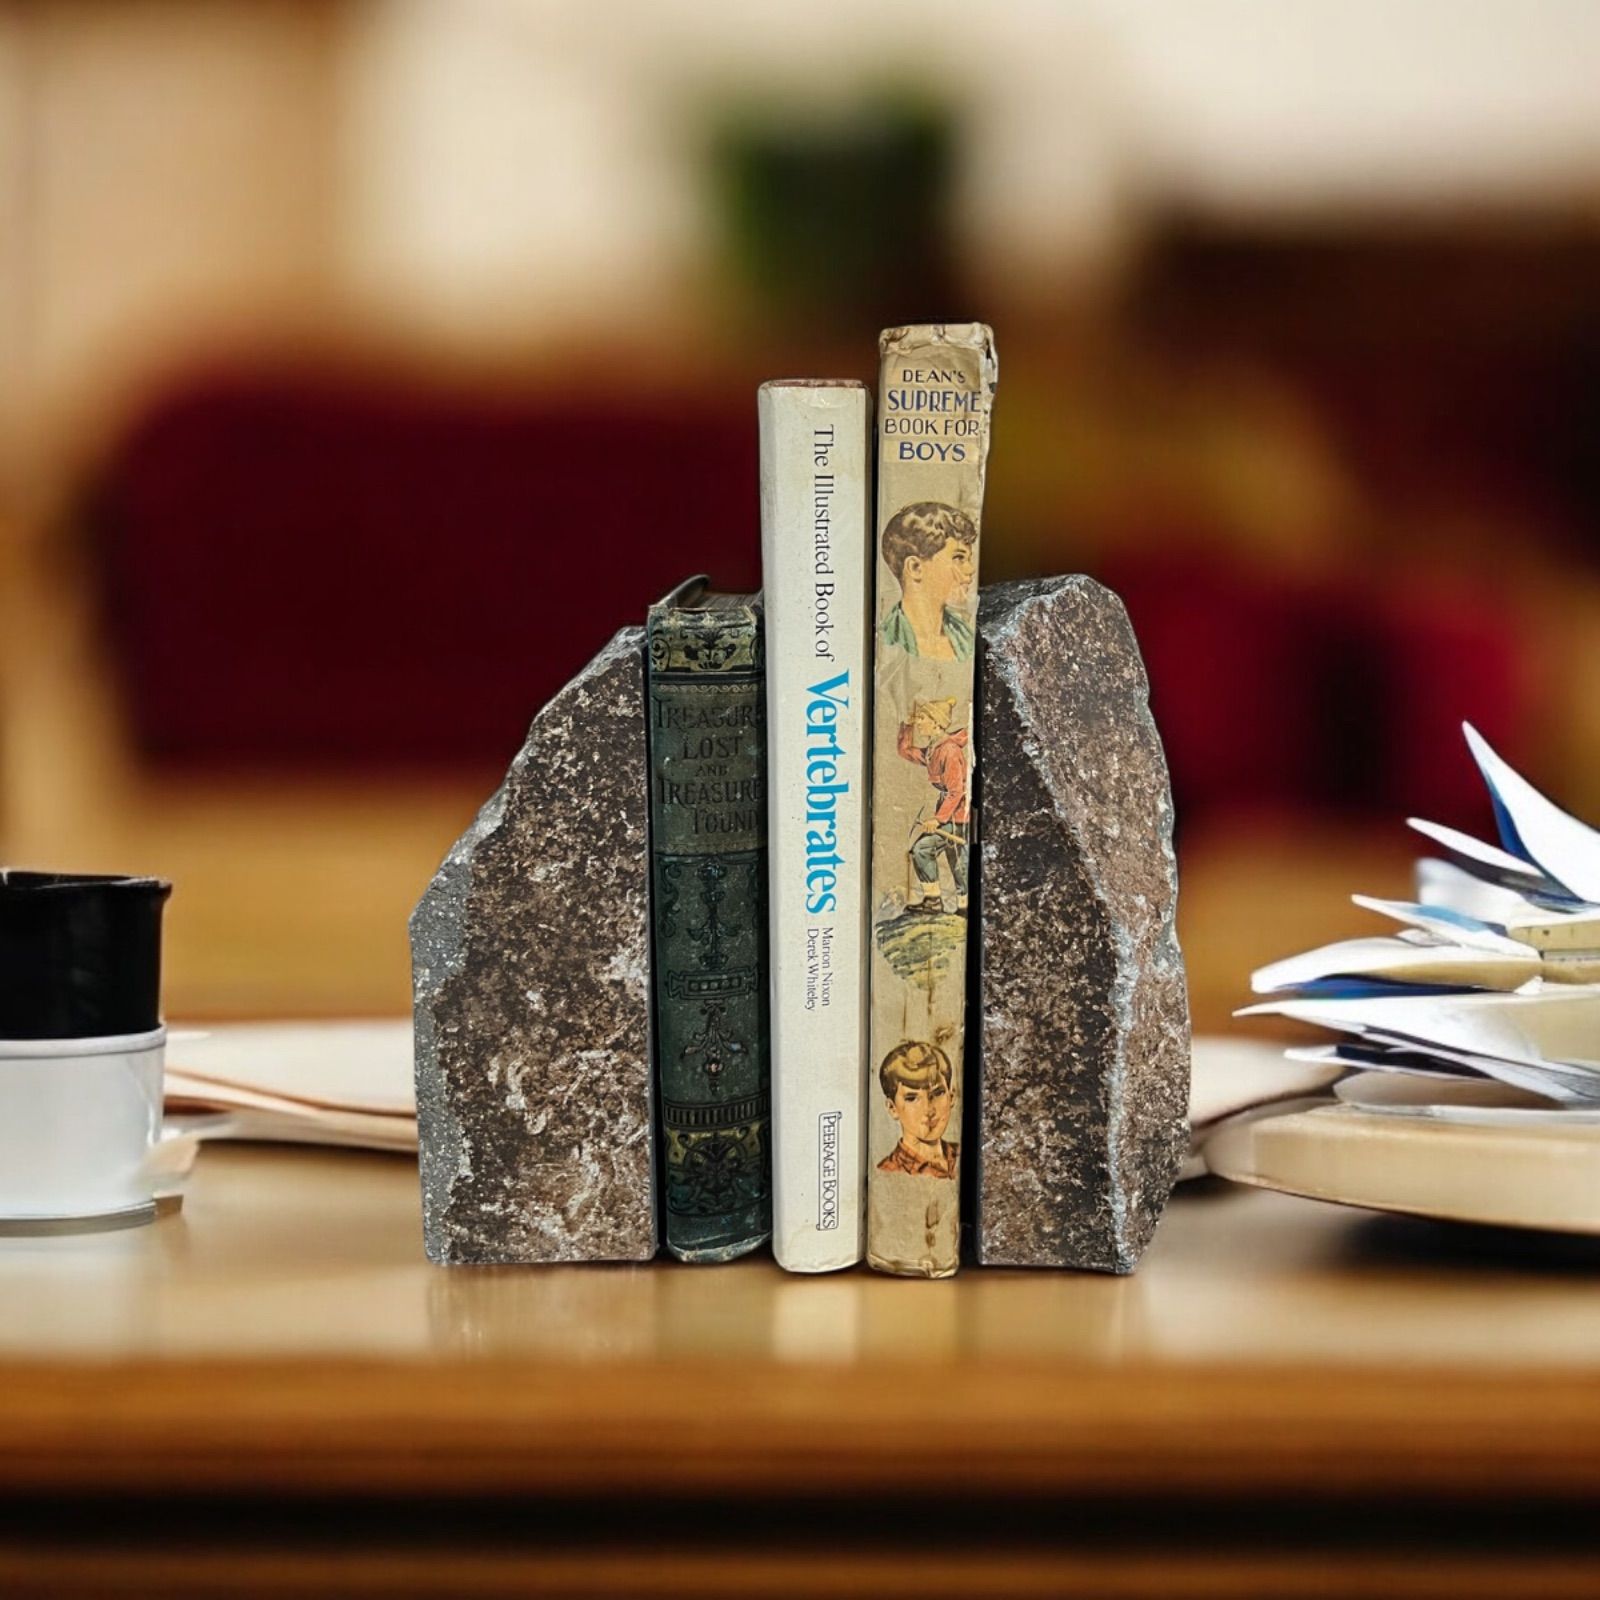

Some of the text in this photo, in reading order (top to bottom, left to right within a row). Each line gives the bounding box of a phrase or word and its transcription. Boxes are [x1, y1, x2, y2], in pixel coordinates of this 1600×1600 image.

[903, 369, 966, 384] DEAN'S
[887, 389, 982, 413] SUPREME
[884, 418, 980, 437] BOOK FOR
[899, 441, 966, 462] BOYS
[814, 424, 836, 663] The Illustrated Book of
[683, 736, 744, 760] LOST
[695, 765, 729, 777] AND
[805, 668, 850, 914] Vertebrates
[804, 928, 819, 1012] Derek Whiteley
[821, 927, 834, 1007] Marion Nixon
[822, 1115, 837, 1229] PEERAGE BOOKS
